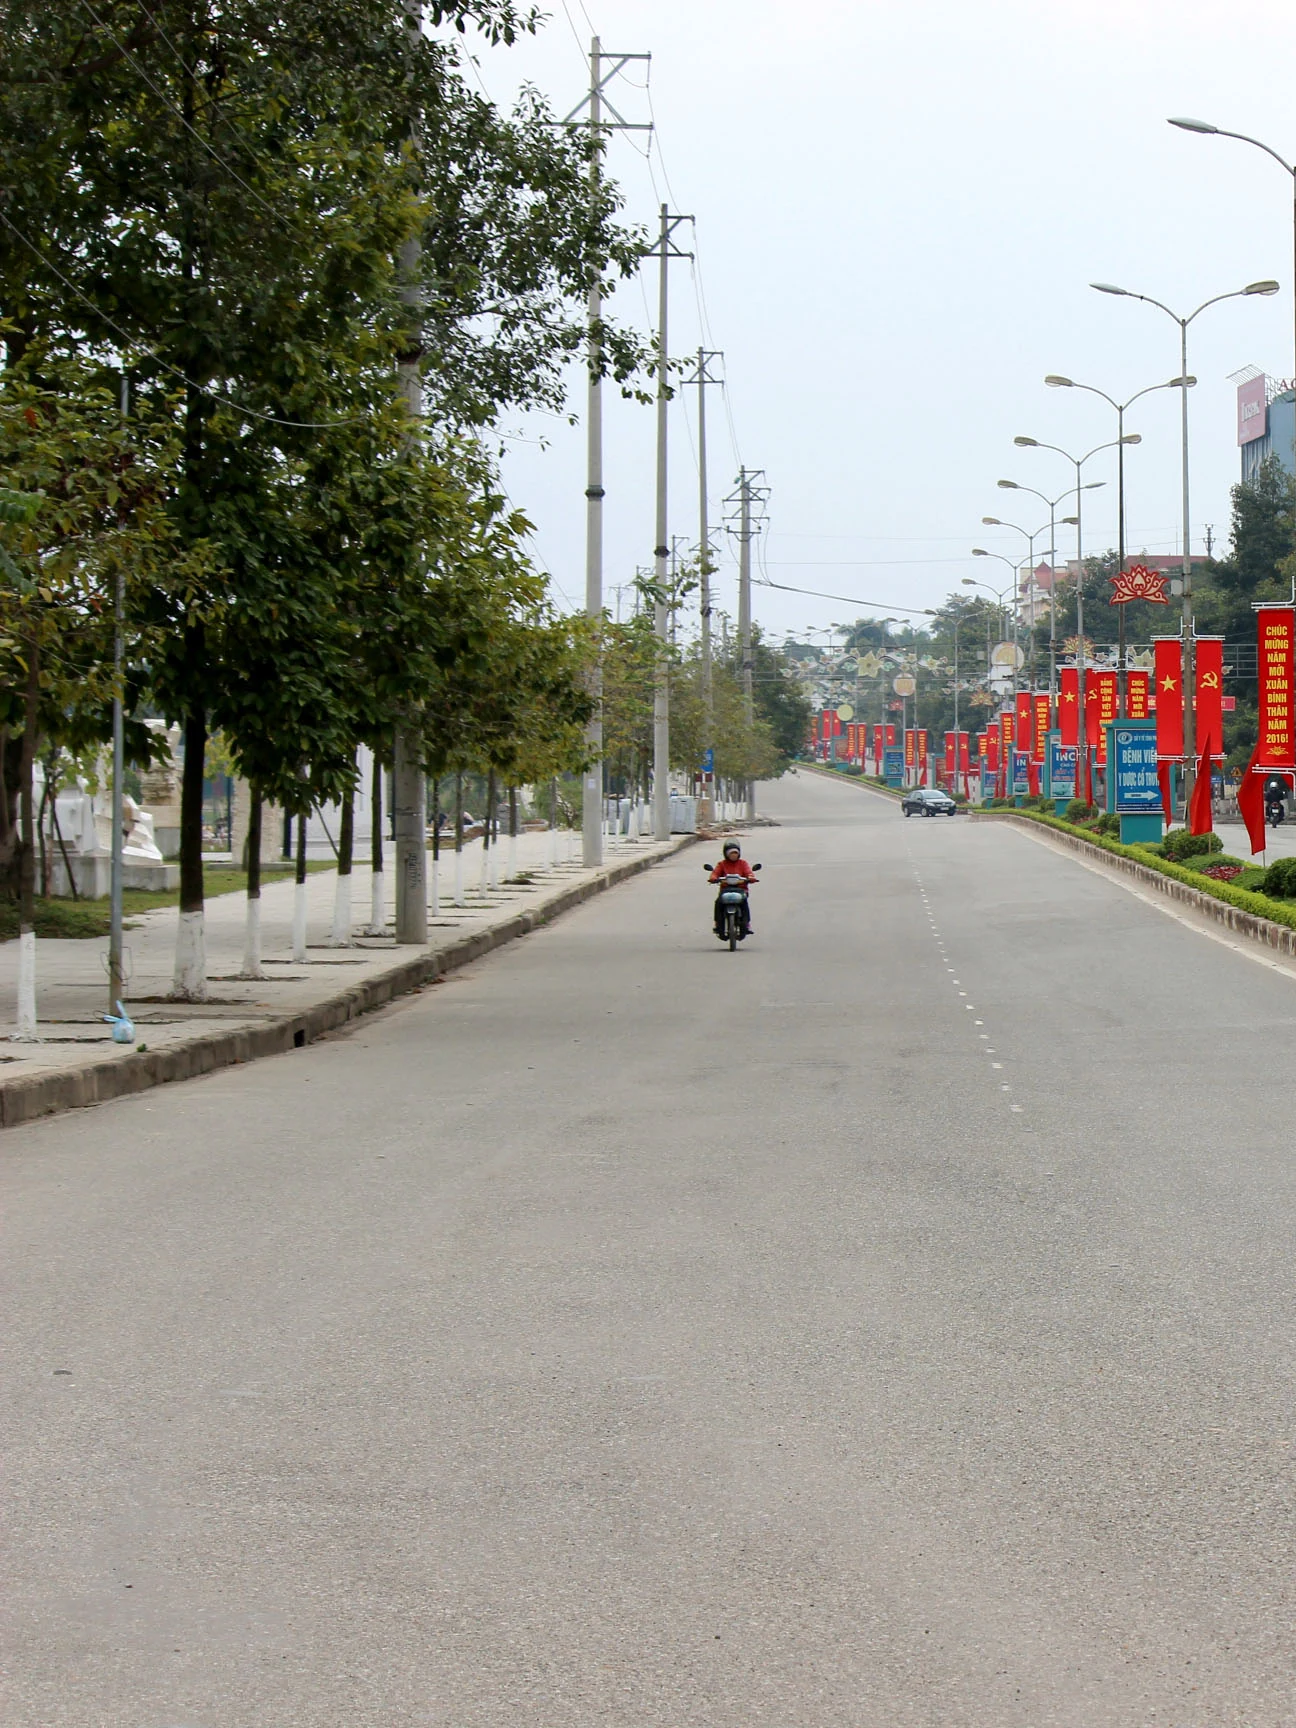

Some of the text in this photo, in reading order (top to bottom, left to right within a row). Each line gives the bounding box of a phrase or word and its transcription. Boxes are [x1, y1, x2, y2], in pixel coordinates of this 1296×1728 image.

[1266, 624, 1288, 636] CHÚC
[1264, 637, 1289, 649] MỪNG
[1267, 651, 1286, 663] NĂM
[1268, 664, 1285, 676] MỚI
[1265, 678, 1288, 690] XUÂN
[1267, 691, 1287, 703] BÍNH
[1266, 705, 1288, 717] THÂN
[1267, 718, 1287, 730] NĂM
[1266, 734, 1289, 743] 2016!
[1122, 746, 1158, 767] BỆNH VIỆ
